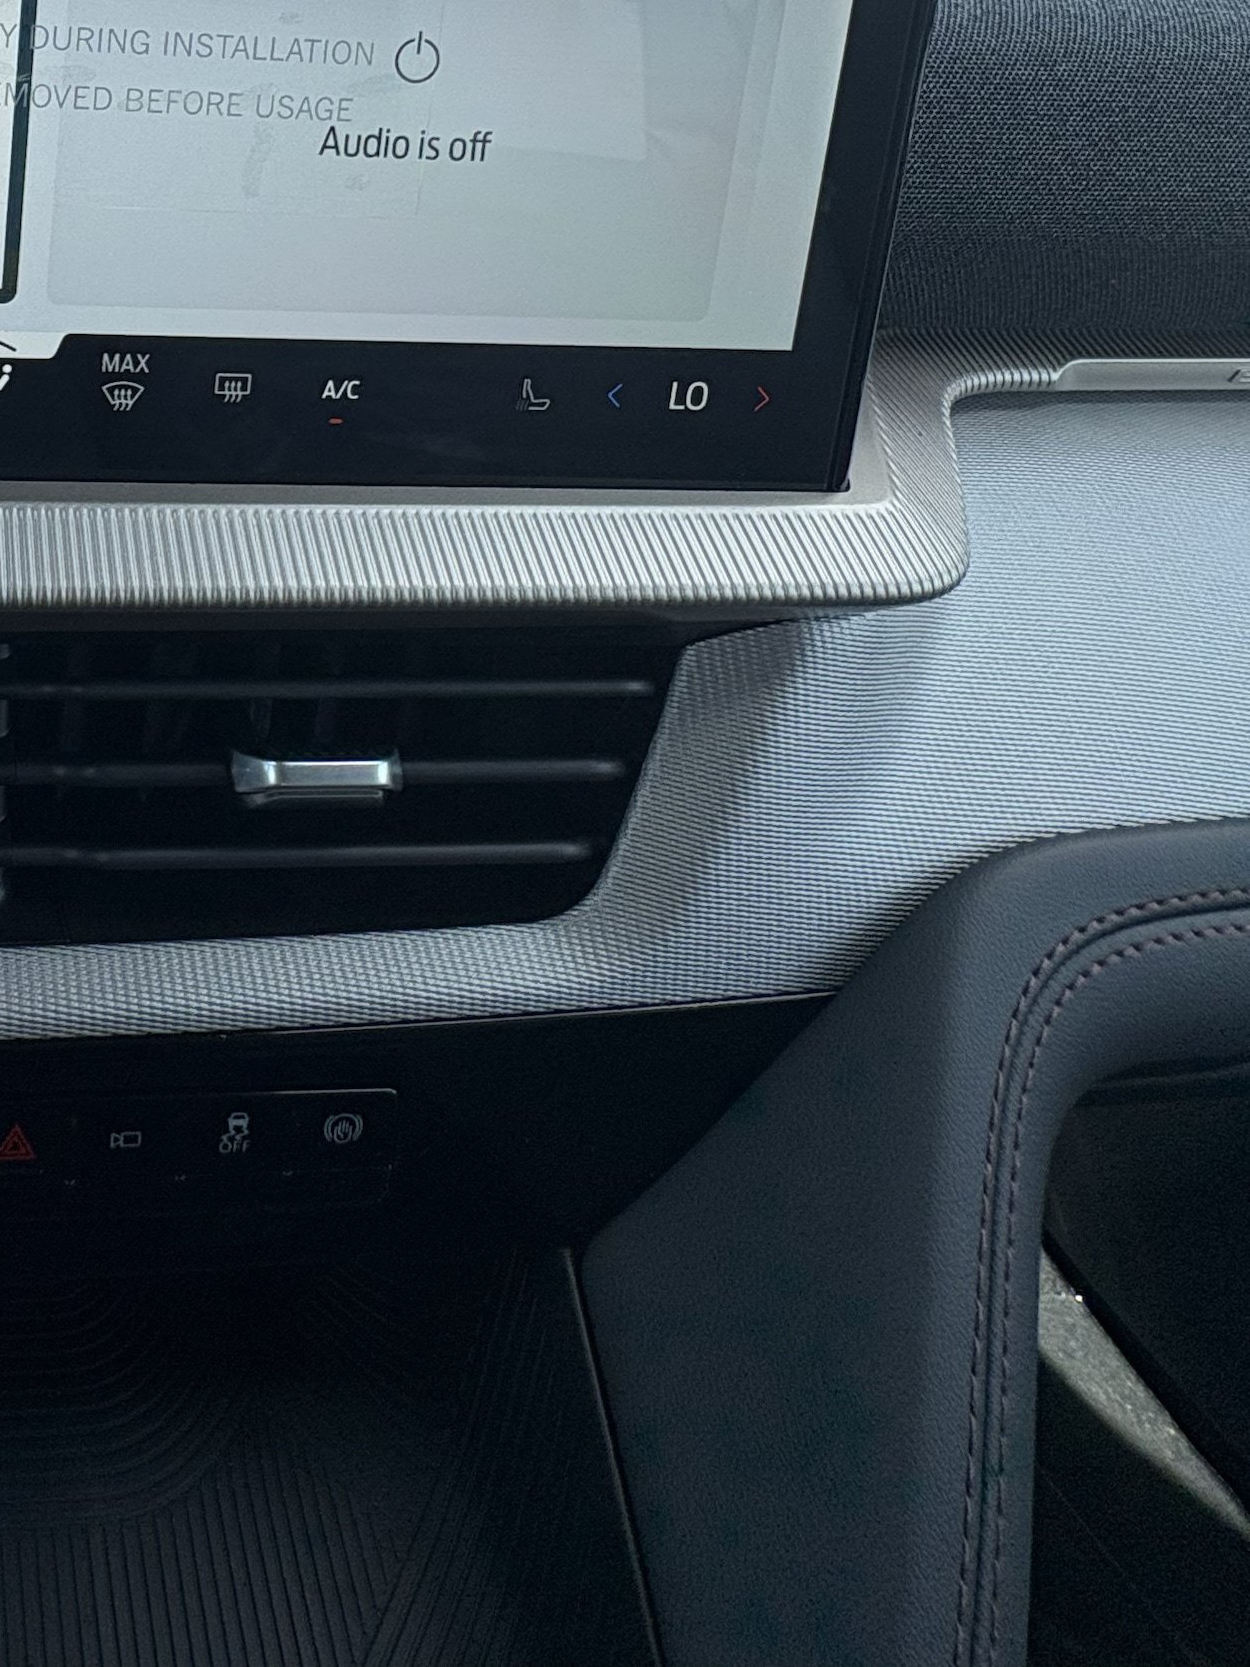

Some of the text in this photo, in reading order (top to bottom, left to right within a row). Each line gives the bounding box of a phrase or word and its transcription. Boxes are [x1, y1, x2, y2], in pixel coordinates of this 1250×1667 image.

[29, 24, 150, 55] DURING
[163, 31, 376, 66] INSTALLATION
[125, 88, 244, 118] BEFORE
[256, 94, 355, 124] USAGE
[319, 125, 494, 163] Audio is off
[101, 353, 150, 374] MAX
[321, 379, 361, 400] A/C
[668, 381, 709, 411] LO
[219, 1140, 250, 1153] OFF
